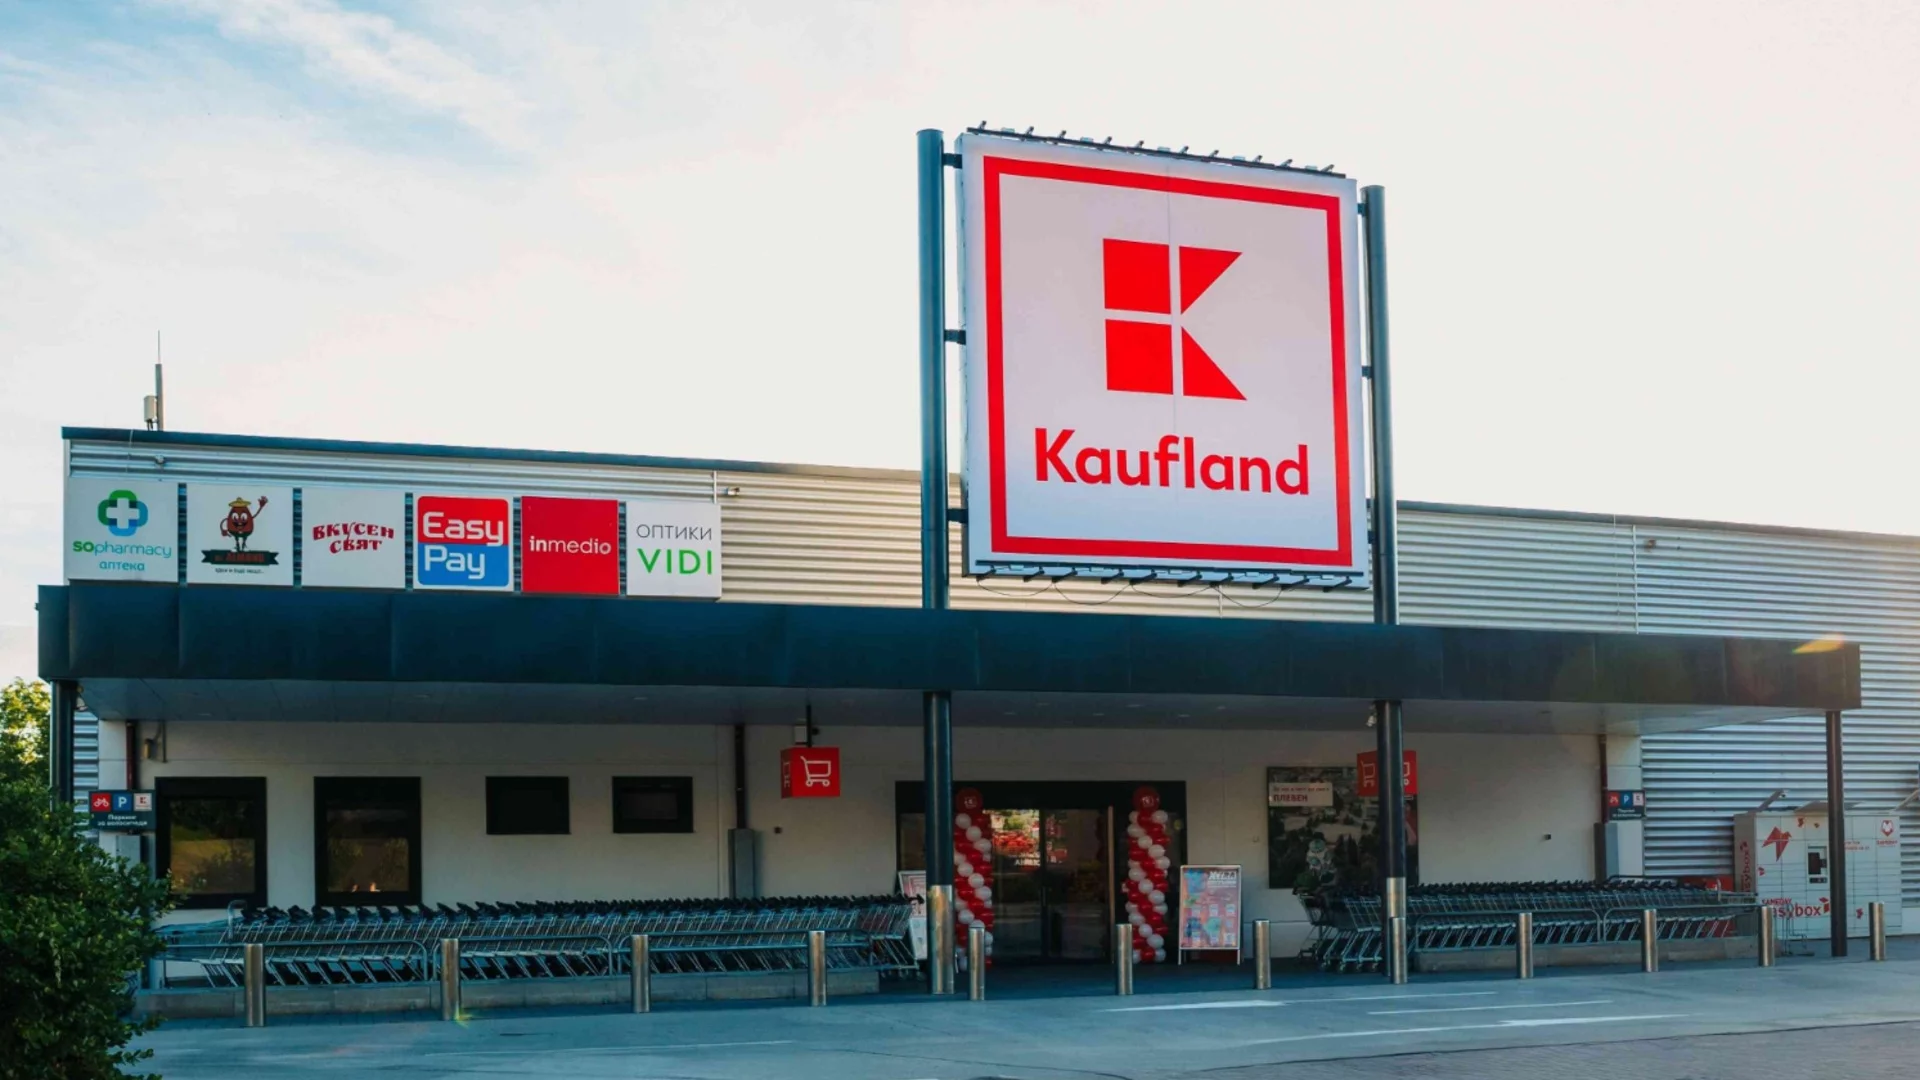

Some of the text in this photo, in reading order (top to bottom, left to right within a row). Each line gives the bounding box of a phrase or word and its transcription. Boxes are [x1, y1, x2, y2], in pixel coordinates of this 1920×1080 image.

[1034, 426, 1310, 496] Kaufland
[312, 522, 395, 541] ВКУСЕН
[423, 511, 504, 547] Easy
[636, 523, 712, 541] ОПТИКИ
[329, 539, 383, 554] СВЯТ
[529, 536, 612, 555] inmedio
[99, 560, 145, 572] аптека
[424, 545, 485, 580] Pay
[637, 548, 713, 575] VIDI
[118, 796, 127, 808] P
